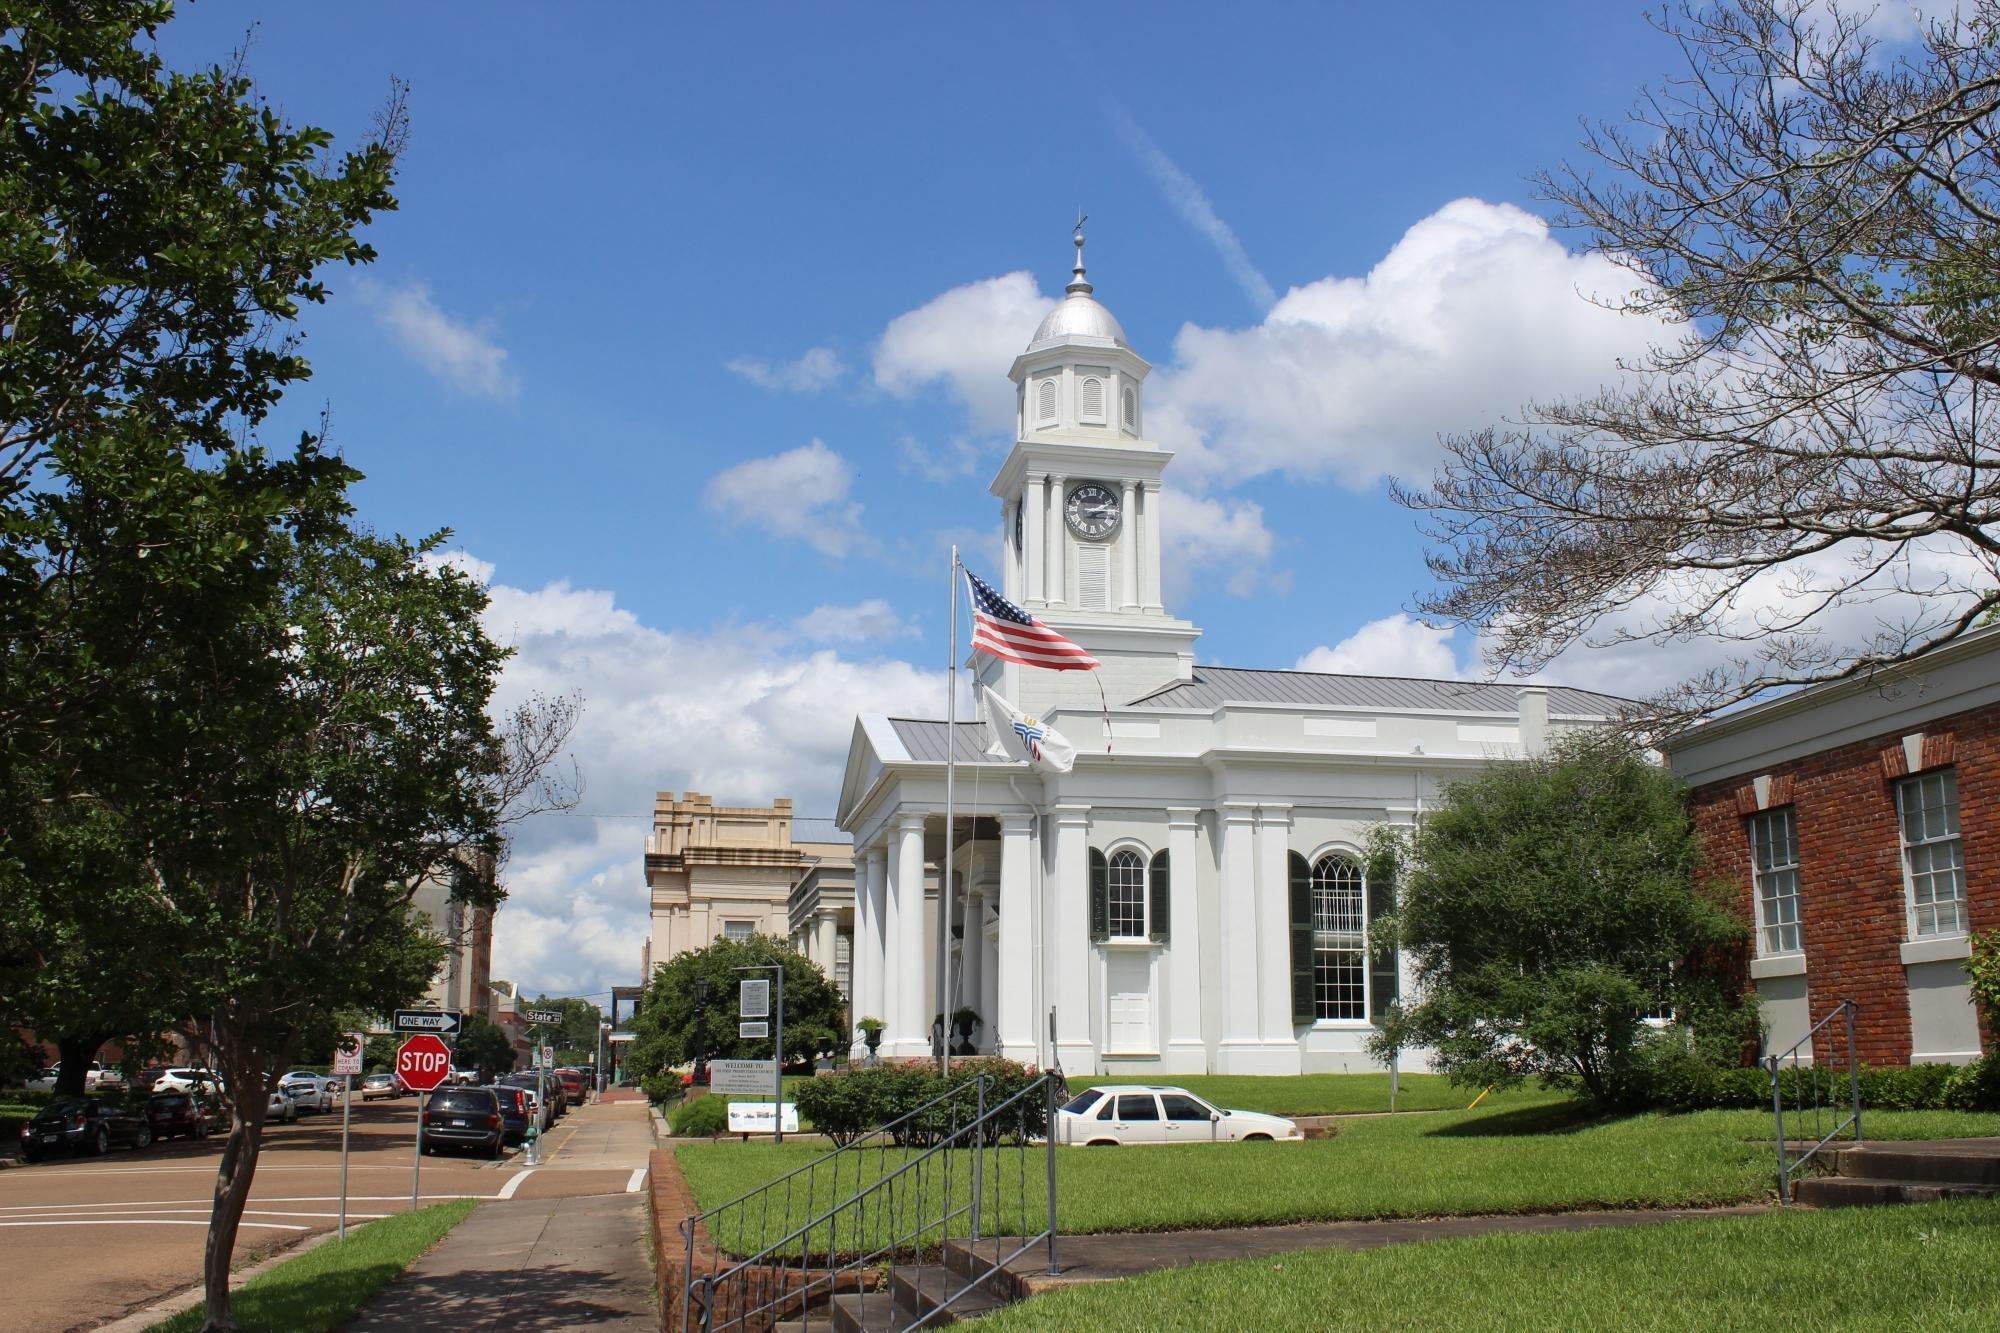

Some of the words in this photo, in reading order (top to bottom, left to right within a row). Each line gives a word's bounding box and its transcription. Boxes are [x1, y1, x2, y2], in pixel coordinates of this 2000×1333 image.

[1087, 488, 1097, 496] XII
[527, 1011, 552, 1021] State
[401, 1017, 419, 1026] ONE
[422, 1017, 441, 1027] WAY
[401, 1051, 447, 1073] STOP
